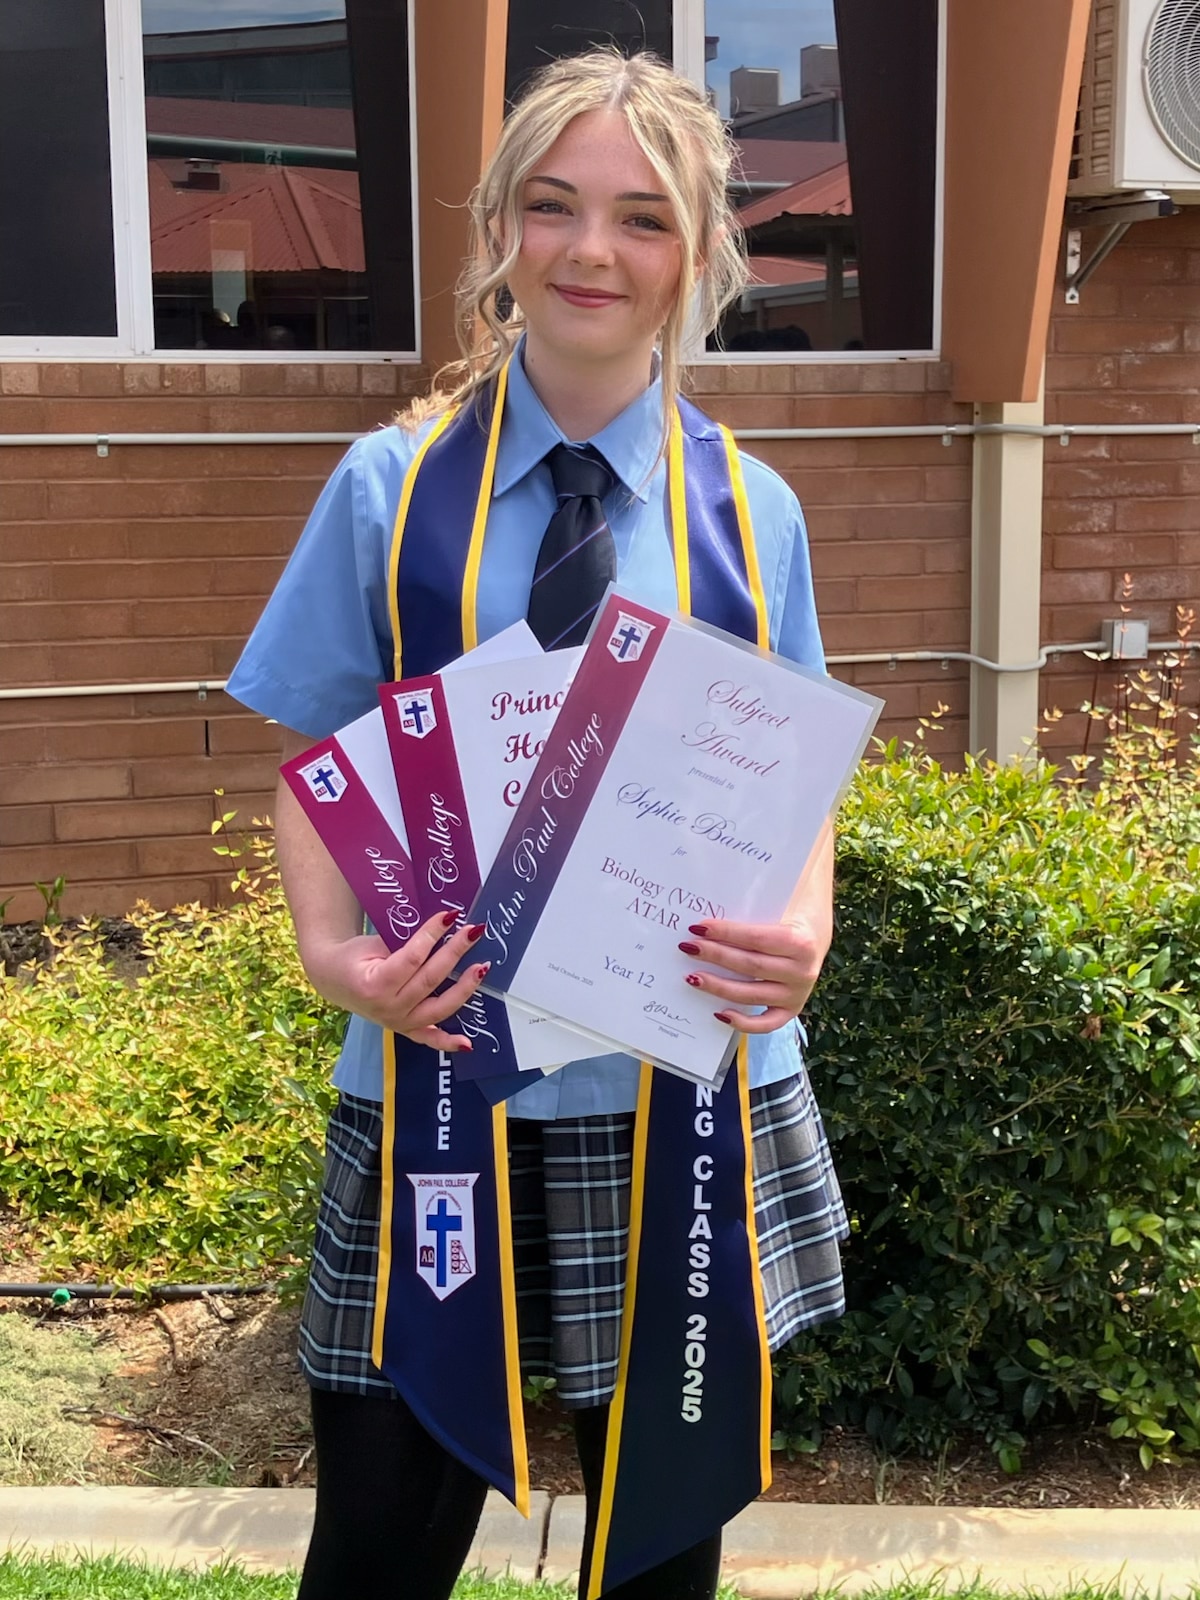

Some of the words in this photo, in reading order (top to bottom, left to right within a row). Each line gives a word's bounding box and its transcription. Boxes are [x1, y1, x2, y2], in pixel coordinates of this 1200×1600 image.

[490, 689, 566, 721] Princ
[705, 679, 791, 730] Subject
[680, 721, 781, 778] Award
[687, 766, 728, 787] presented
[726, 782, 735, 791] to
[426, 792, 463, 893] College
[484, 888, 526, 966] John
[512, 805, 558, 883] Paul
[541, 712, 604, 800] College
[616, 782, 687, 826] Sophie
[690, 812, 774, 863] Barton
[671, 846, 688, 857] for
[365, 846, 421, 940] College
[600, 856, 665, 900] Biology
[667, 887, 725, 921] (ViSN)
[625, 896, 681, 932] ATAR
[603, 955, 634, 980] Year
[637, 971, 655, 988] 12
[634, 943, 645, 951] in
[437, 1050, 452, 1150] LEGE
[417, 1179, 432, 1187] JOHN
[445, 1178, 470, 1187] COLLEGE
[687, 1155, 714, 1298] CLASS
[680, 1313, 708, 1424] 2025
